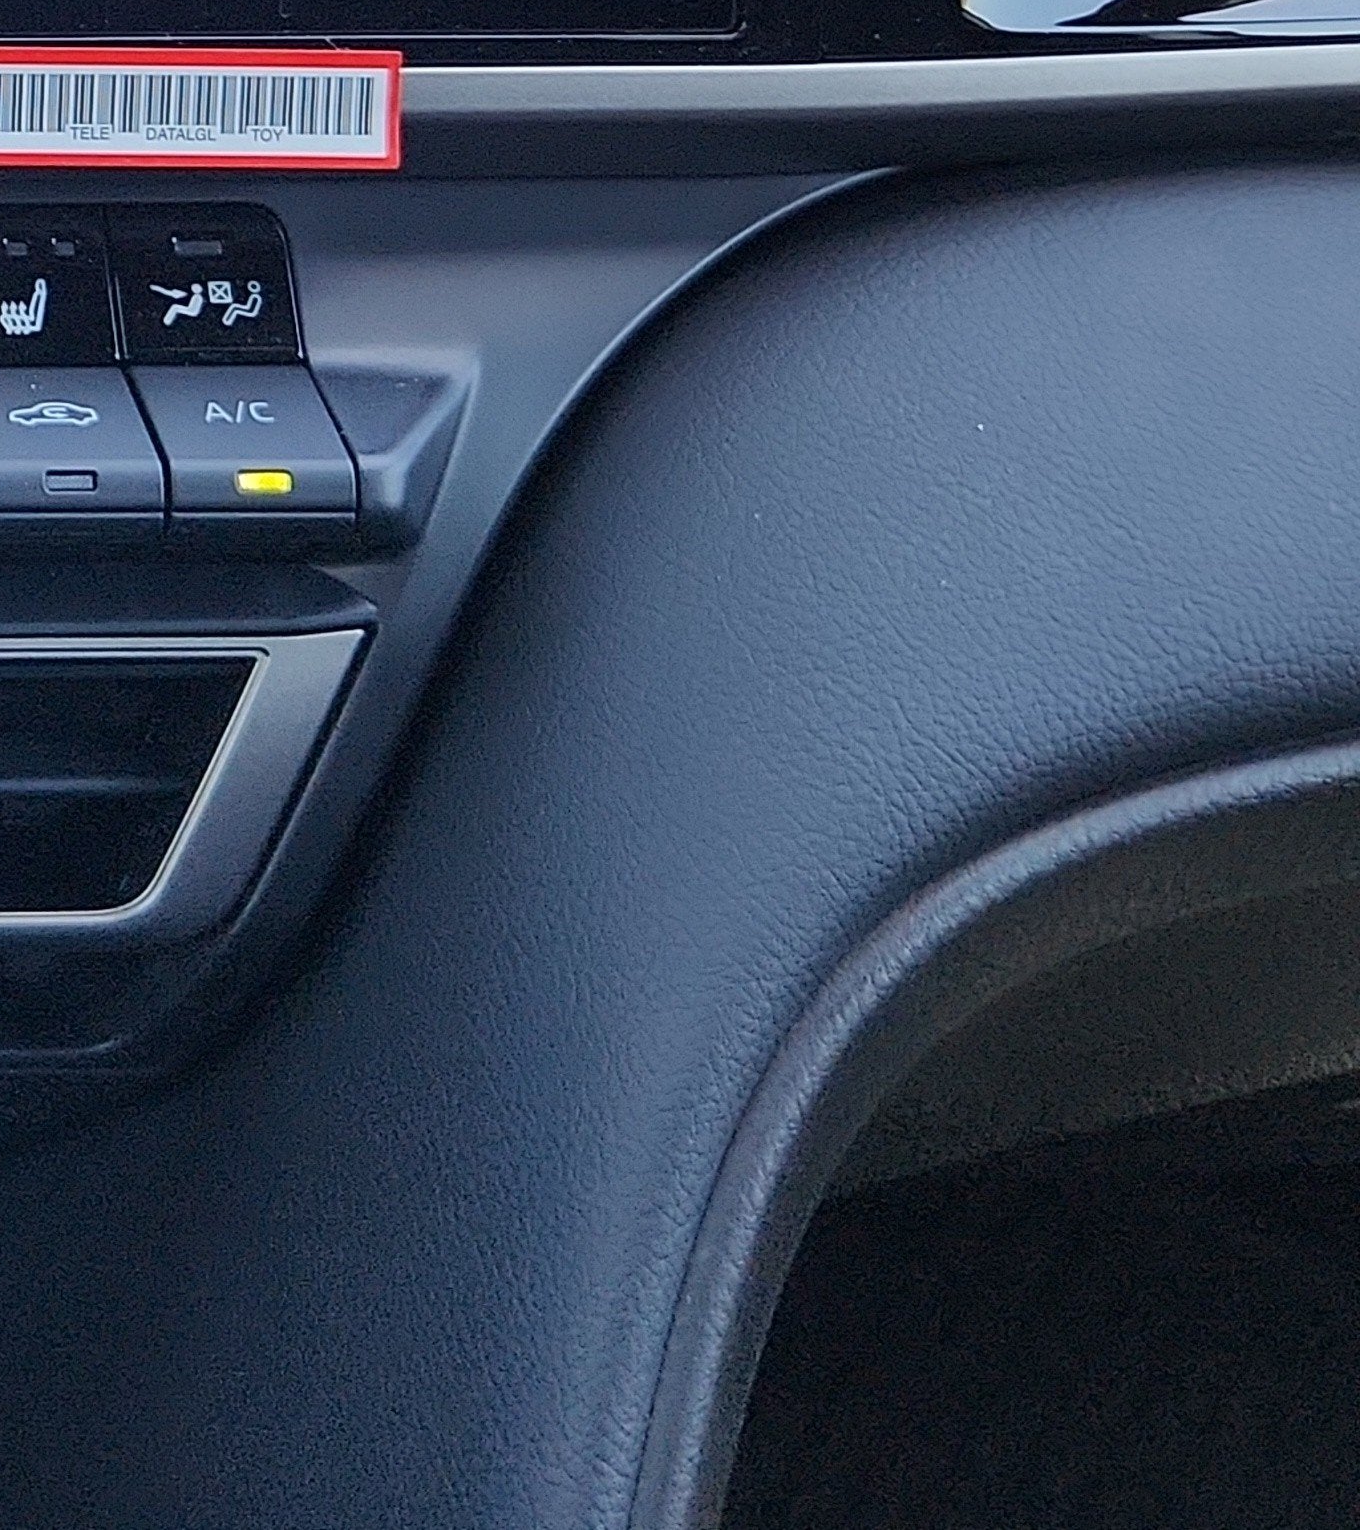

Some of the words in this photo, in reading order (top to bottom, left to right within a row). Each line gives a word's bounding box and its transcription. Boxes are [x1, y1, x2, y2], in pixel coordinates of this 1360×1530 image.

[70, 126, 111, 141] TELE
[145, 127, 216, 142] DATALGL
[251, 128, 285, 143] TOY
[205, 399, 276, 425] A/C
